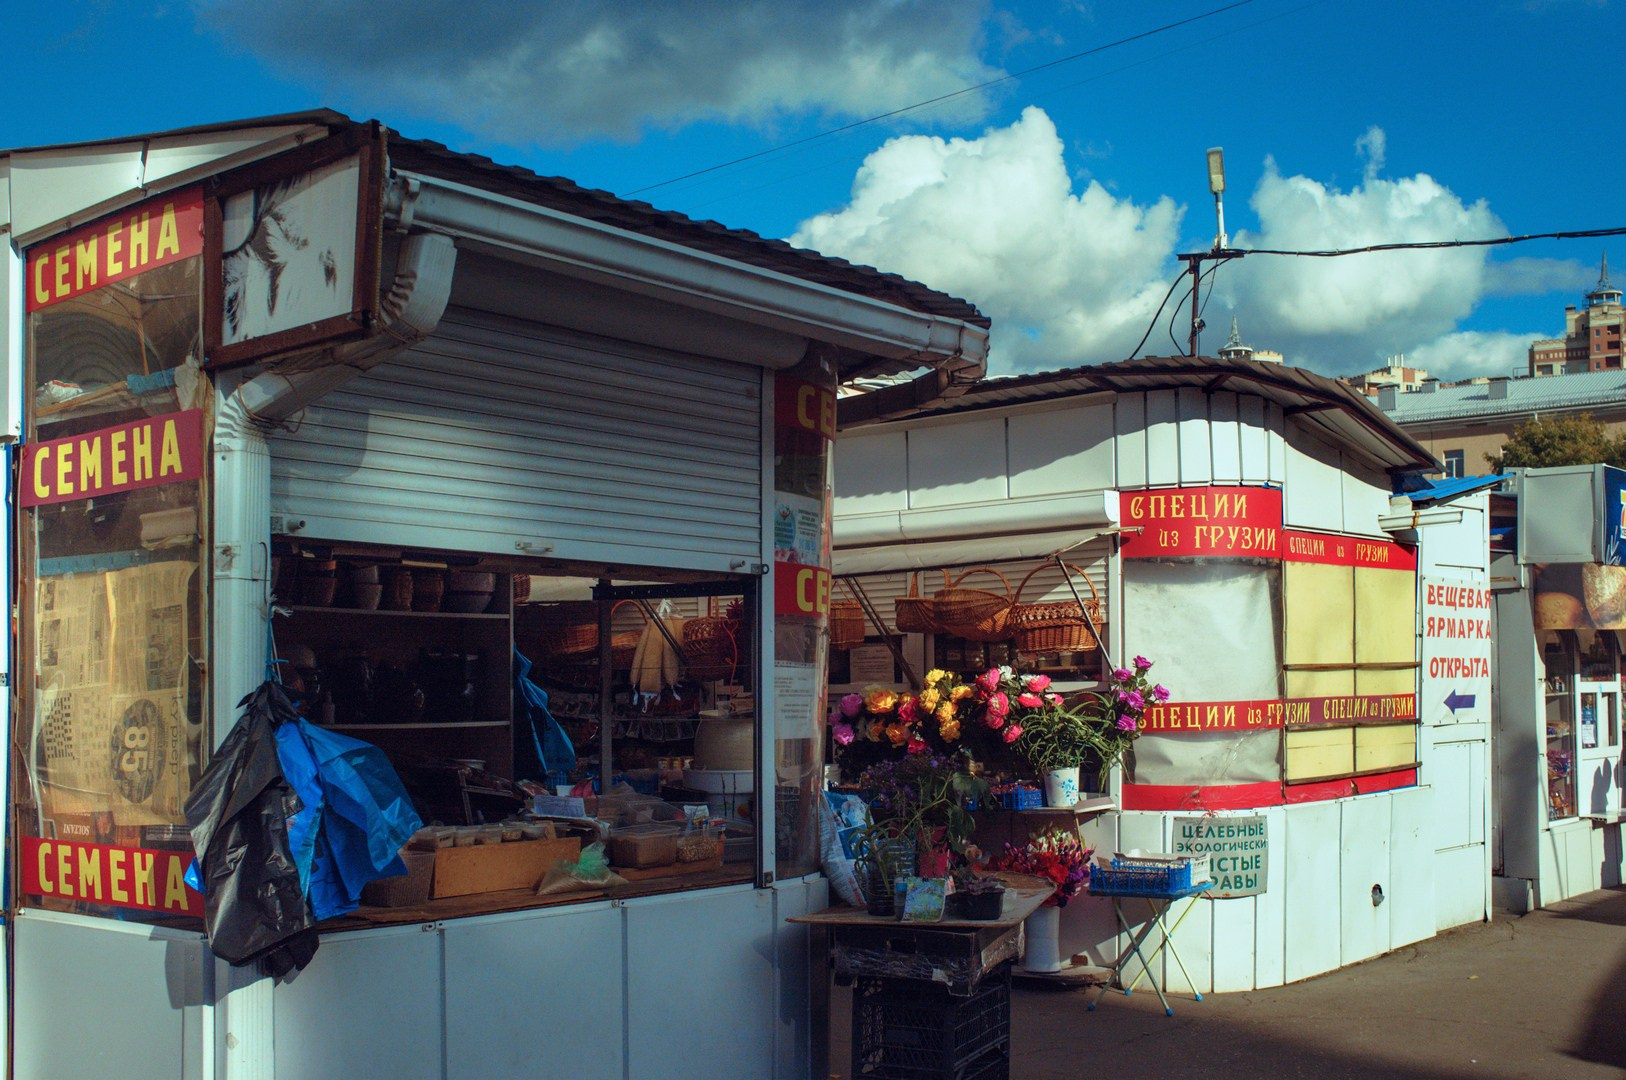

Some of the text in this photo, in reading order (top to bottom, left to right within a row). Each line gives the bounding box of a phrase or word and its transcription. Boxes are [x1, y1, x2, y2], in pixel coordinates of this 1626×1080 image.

[35, 202, 180, 304] СЕМЕНА
[798, 385, 837, 436] СЕ
[34, 419, 183, 498] СЕМЕНА
[1130, 493, 1248, 522] СПЕЦИИ
[1194, 525, 1277, 551] ГРУЗИИ
[1289, 536, 1326, 557] СПЕЦИИ
[1355, 543, 1390, 563] ГРУЗИИ
[797, 568, 832, 614] СЕ
[1427, 584, 1491, 611] ВЕЩЕВАЯ
[1426, 616, 1491, 639] ЯРМАРКА
[1429, 657, 1489, 679] ОТКРЫТА
[1267, 701, 1310, 725] ГРУЗИИ
[1323, 698, 1368, 720] СПЕЦИИ
[1380, 697, 1414, 718] ГРУЗИИ
[121, 725, 150, 773] 85
[1182, 823, 1264, 839] ЦЕЛЕБНЫЕ
[1176, 839, 1267, 853] ЭКОЛОГИЧЕСКИ
[38, 843, 189, 911] СЕМЕНА
